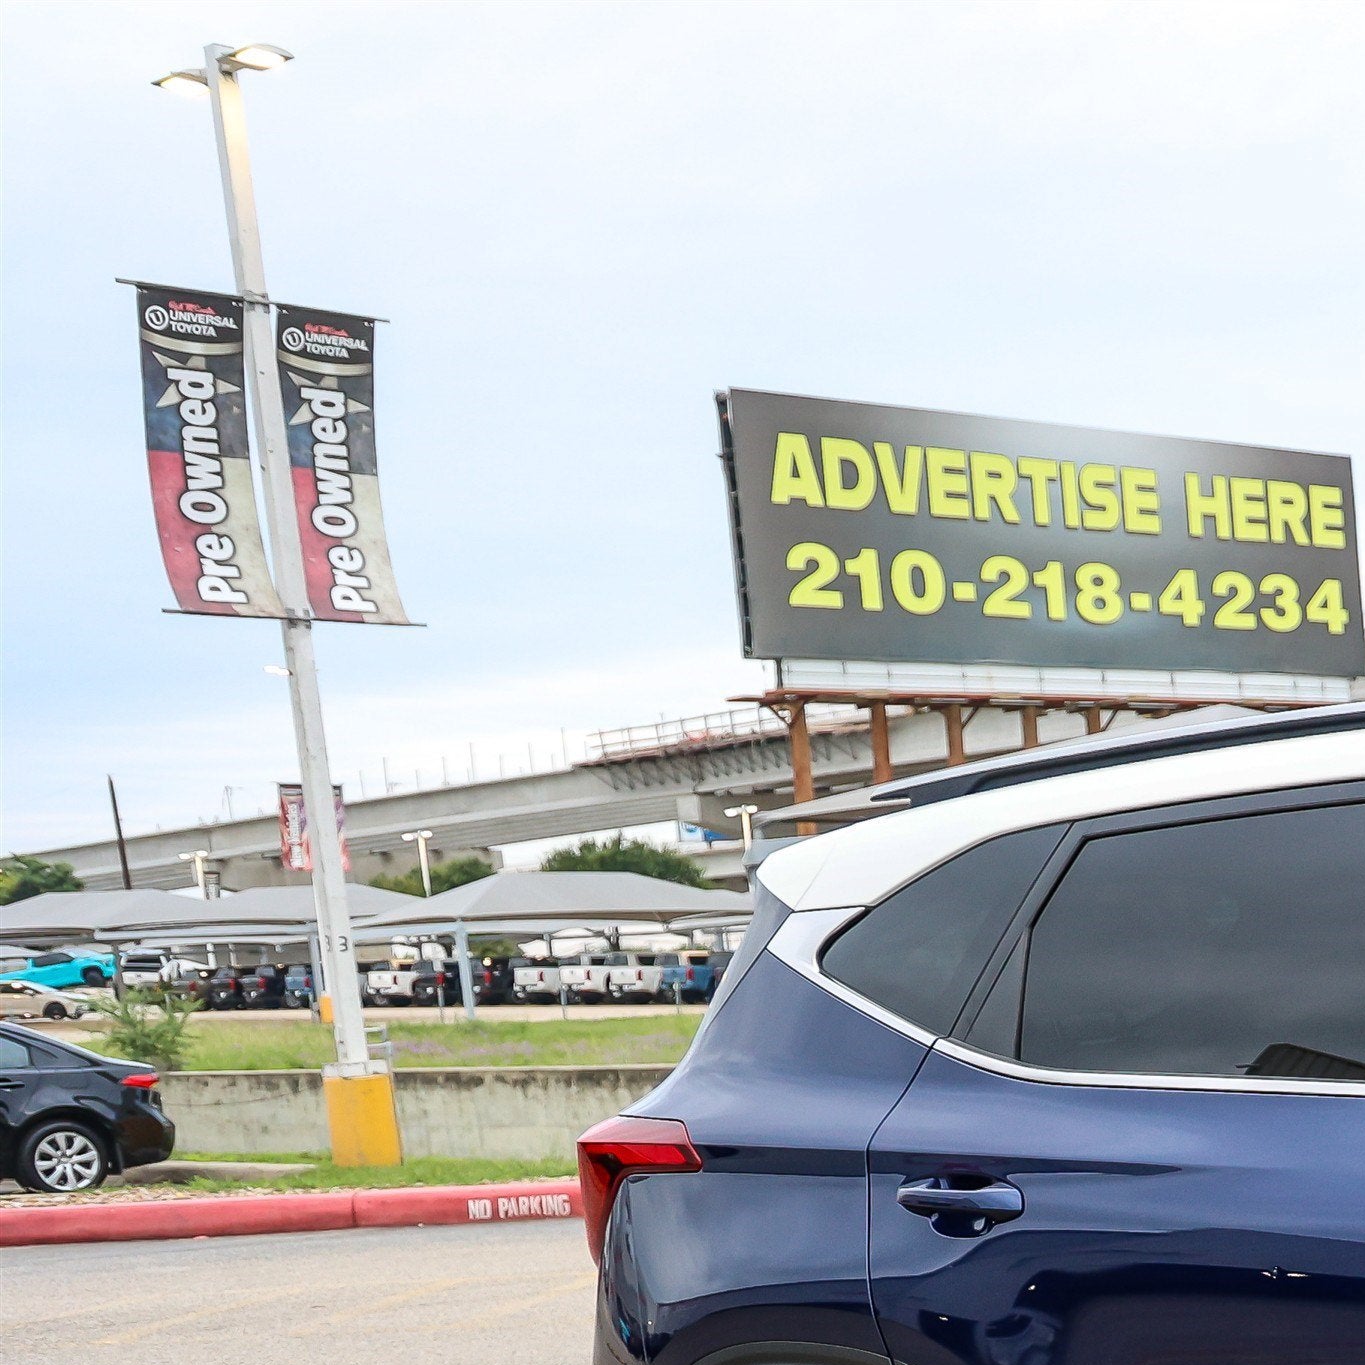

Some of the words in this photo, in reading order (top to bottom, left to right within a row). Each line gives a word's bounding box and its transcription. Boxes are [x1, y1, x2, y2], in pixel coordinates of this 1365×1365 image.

[169, 309, 239, 329] UNIVERSAL
[169, 321, 218, 337] TOYOTA
[305, 332, 369, 351] UNIVERSAL
[305, 342, 350, 359] TOYOTA
[167, 368, 229, 525] Owned
[301, 387, 359, 538] Owned
[770, 432, 1163, 536] ADVERTISE
[1184, 472, 1347, 549] HERE
[196, 533, 249, 604] Pre
[329, 545, 379, 612] Pre
[785, 541, 1350, 635] 210-218-4234
[467, 1199, 493, 1220] NO
[497, 1194, 571, 1219] PARKING
